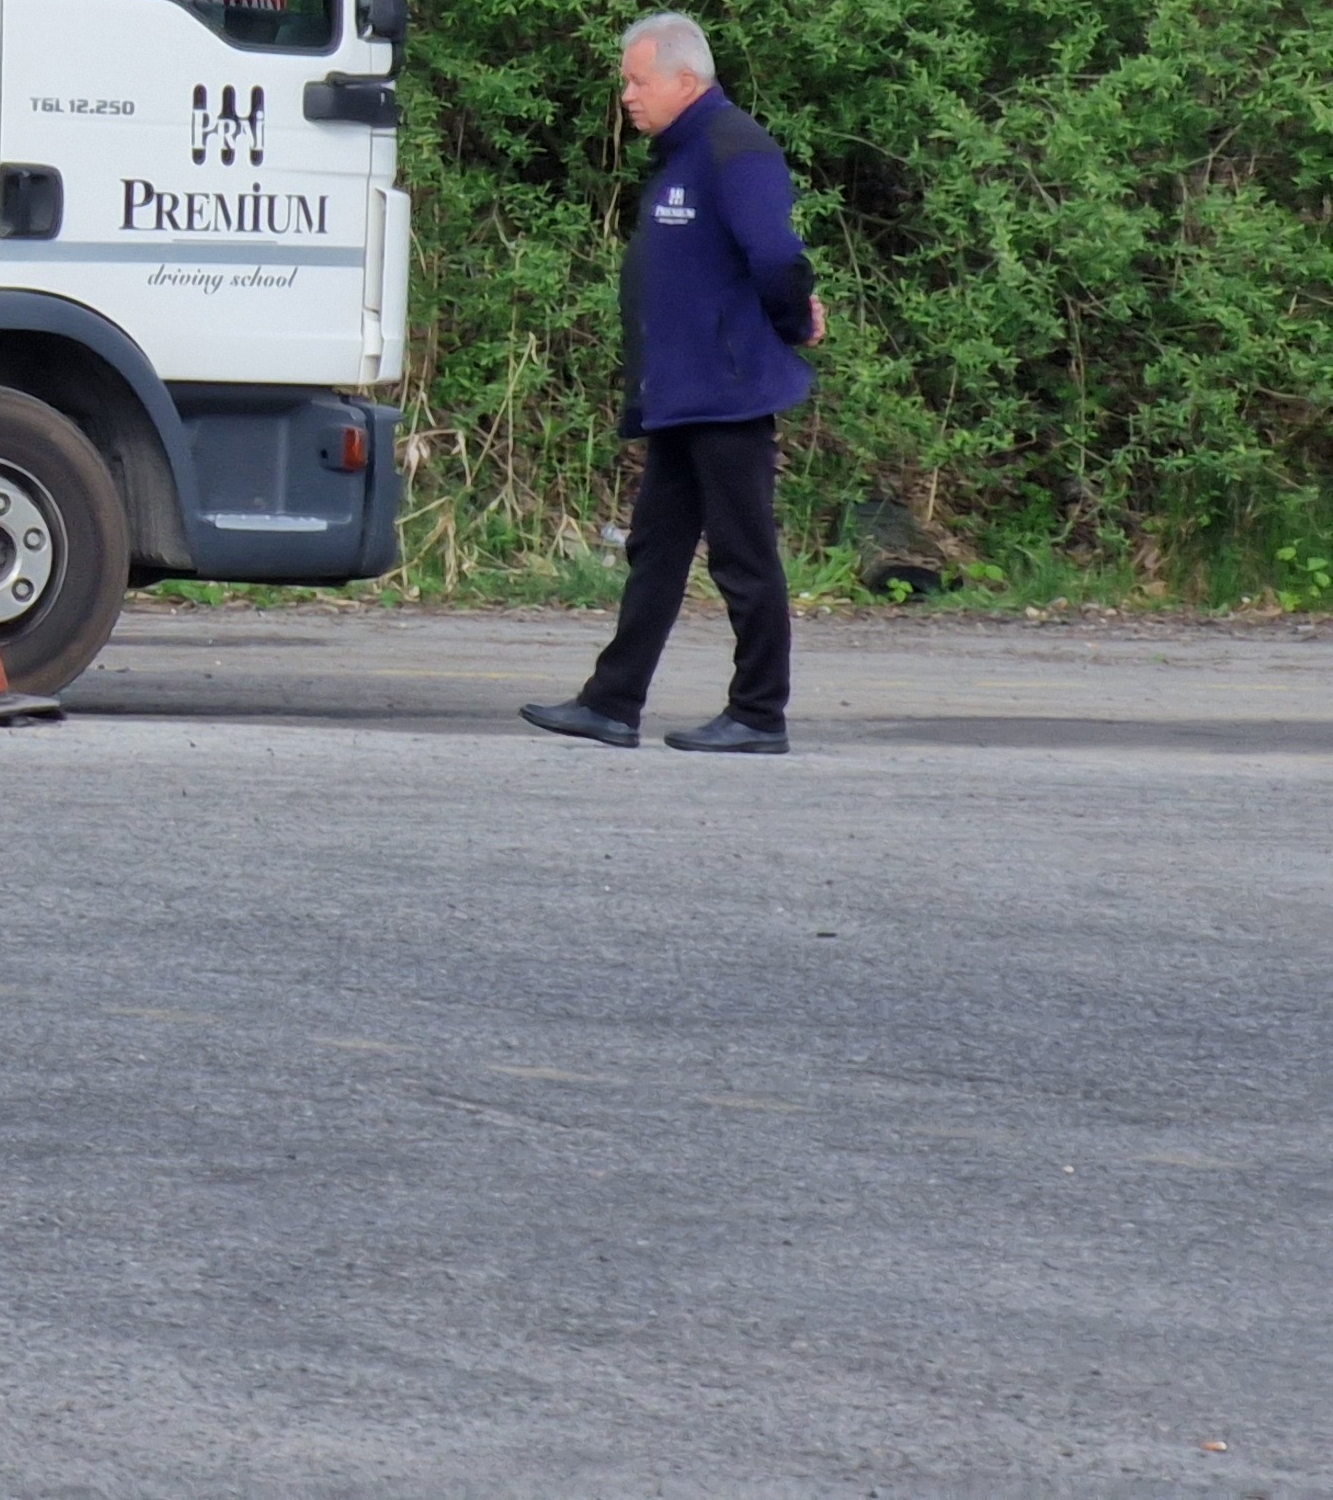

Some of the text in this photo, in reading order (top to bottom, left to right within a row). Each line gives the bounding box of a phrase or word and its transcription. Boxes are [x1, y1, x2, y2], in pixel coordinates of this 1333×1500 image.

[69, 98, 135, 116] 12.250
[146, 264, 298, 295] driving school
